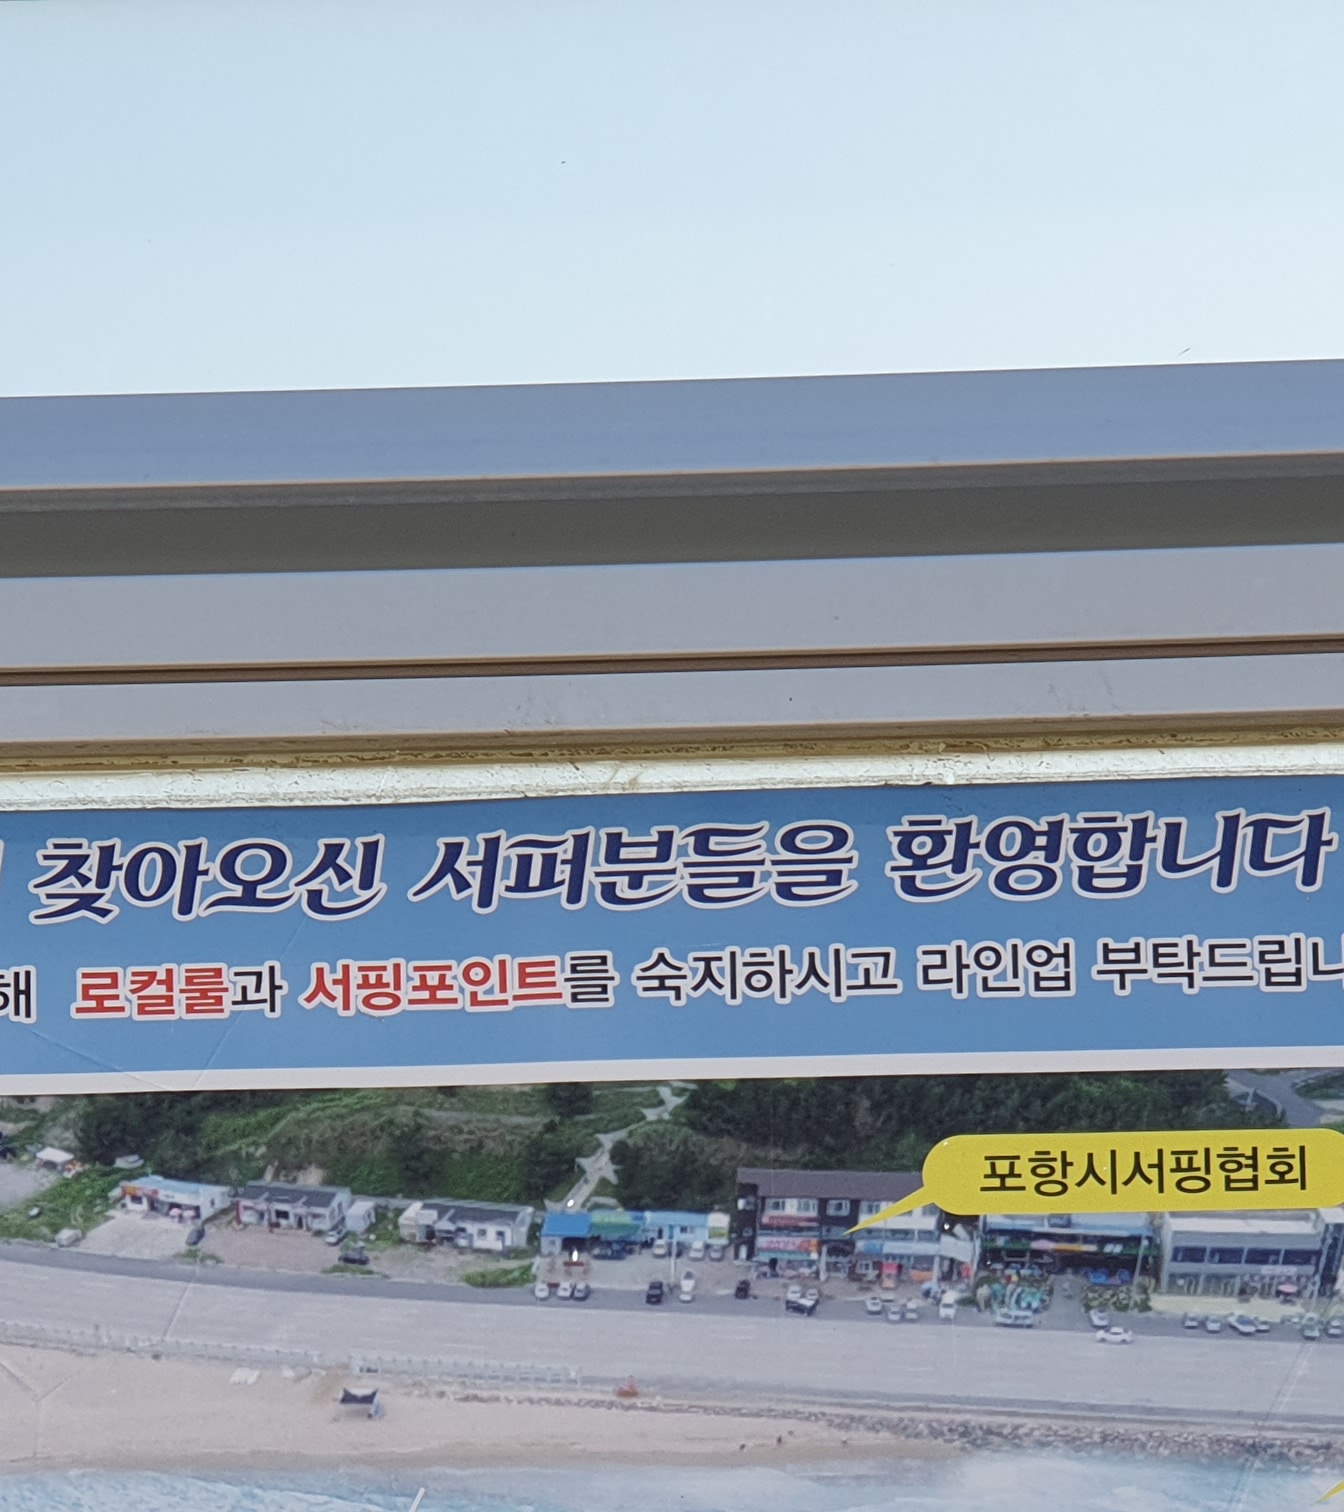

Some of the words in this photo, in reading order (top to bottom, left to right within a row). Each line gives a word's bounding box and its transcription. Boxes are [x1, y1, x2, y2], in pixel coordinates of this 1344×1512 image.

[30, 833, 384, 926] 찾아오신
[407, 821, 861, 913] 서퍼분들을
[888, 806, 1336, 902] 환영합니다
[72, 959, 284, 1023] 로컬룰과
[301, 950, 622, 1018] 서핑포인트를
[633, 942, 903, 1005] 숙지하시고
[915, 938, 1075, 1000] 라인업
[979, 1145, 1309, 1197] 포항시서핑협회
